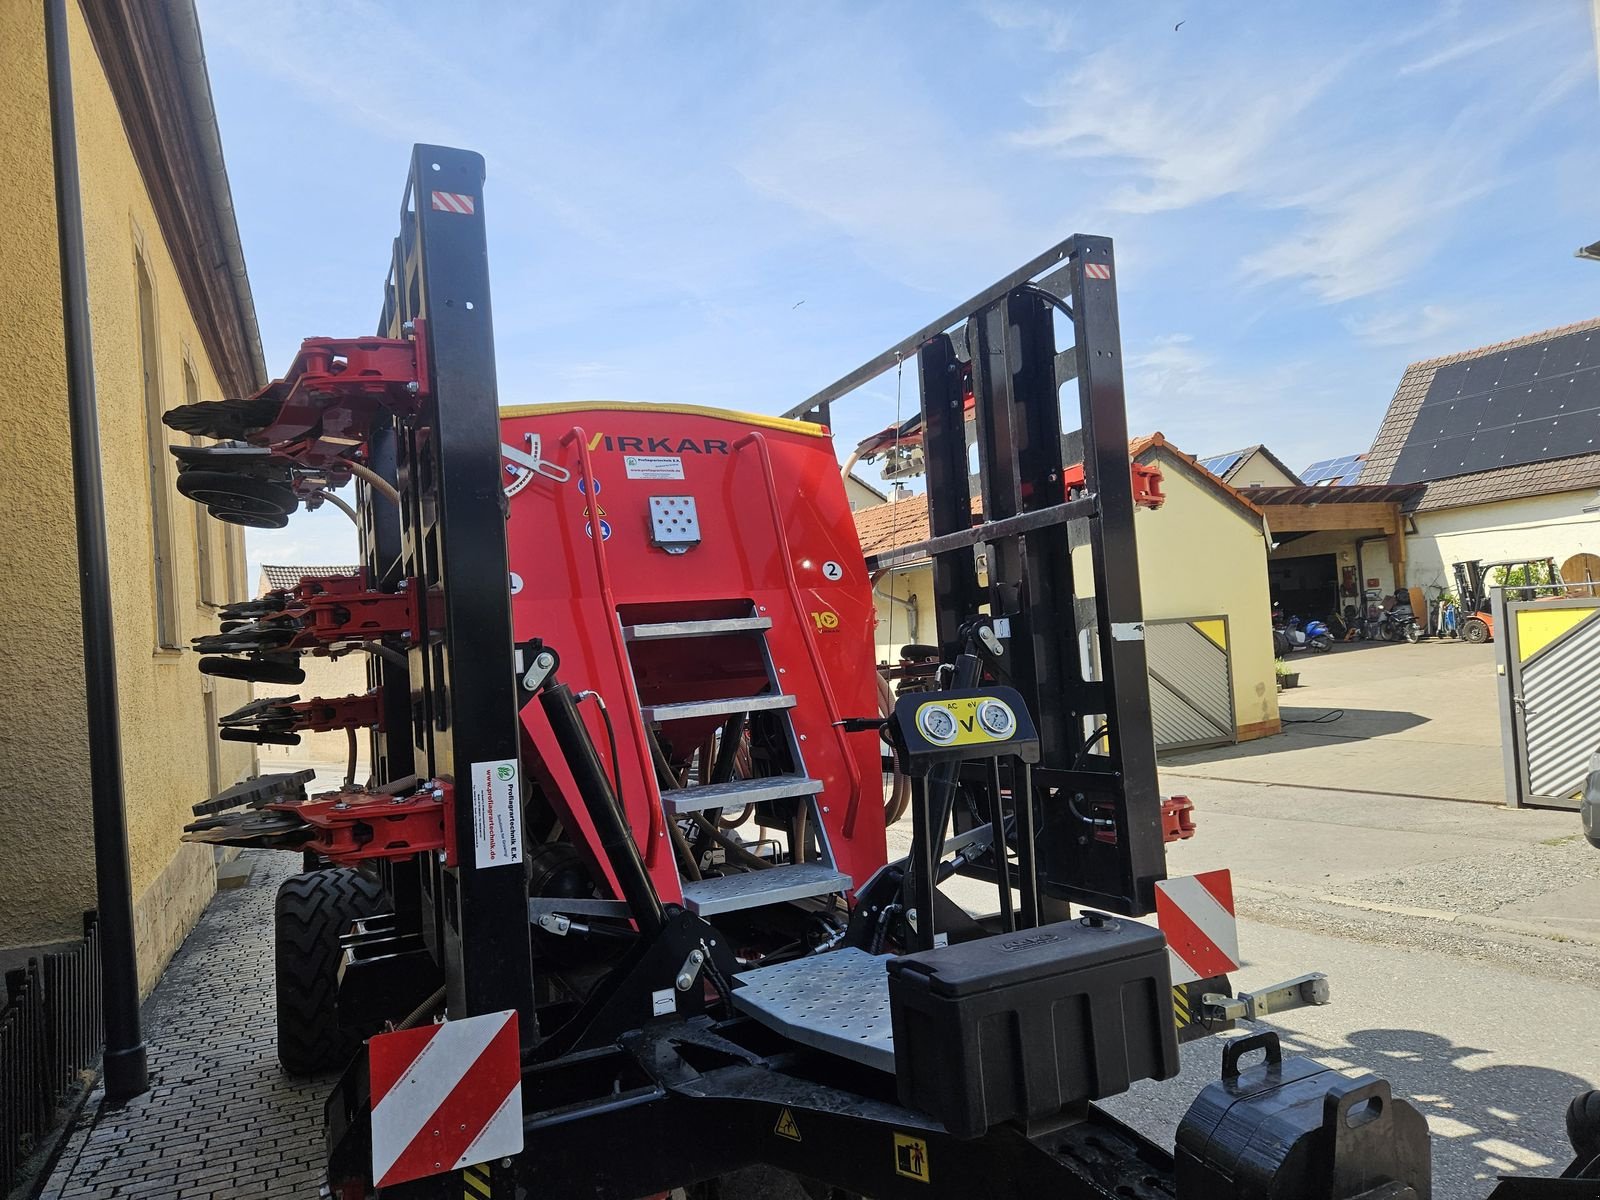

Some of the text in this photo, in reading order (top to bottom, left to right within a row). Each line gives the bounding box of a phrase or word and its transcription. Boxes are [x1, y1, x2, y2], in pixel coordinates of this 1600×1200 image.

[587, 432, 729, 455] VIRKAR
[827, 563, 838, 576] 2
[811, 611, 839, 629] 10
[947, 702, 958, 710] AC
[959, 715, 974, 733] V
[486, 769, 496, 860] www.profiagrartechnik.de
[507, 783, 517, 846] Profiagrartechnik
